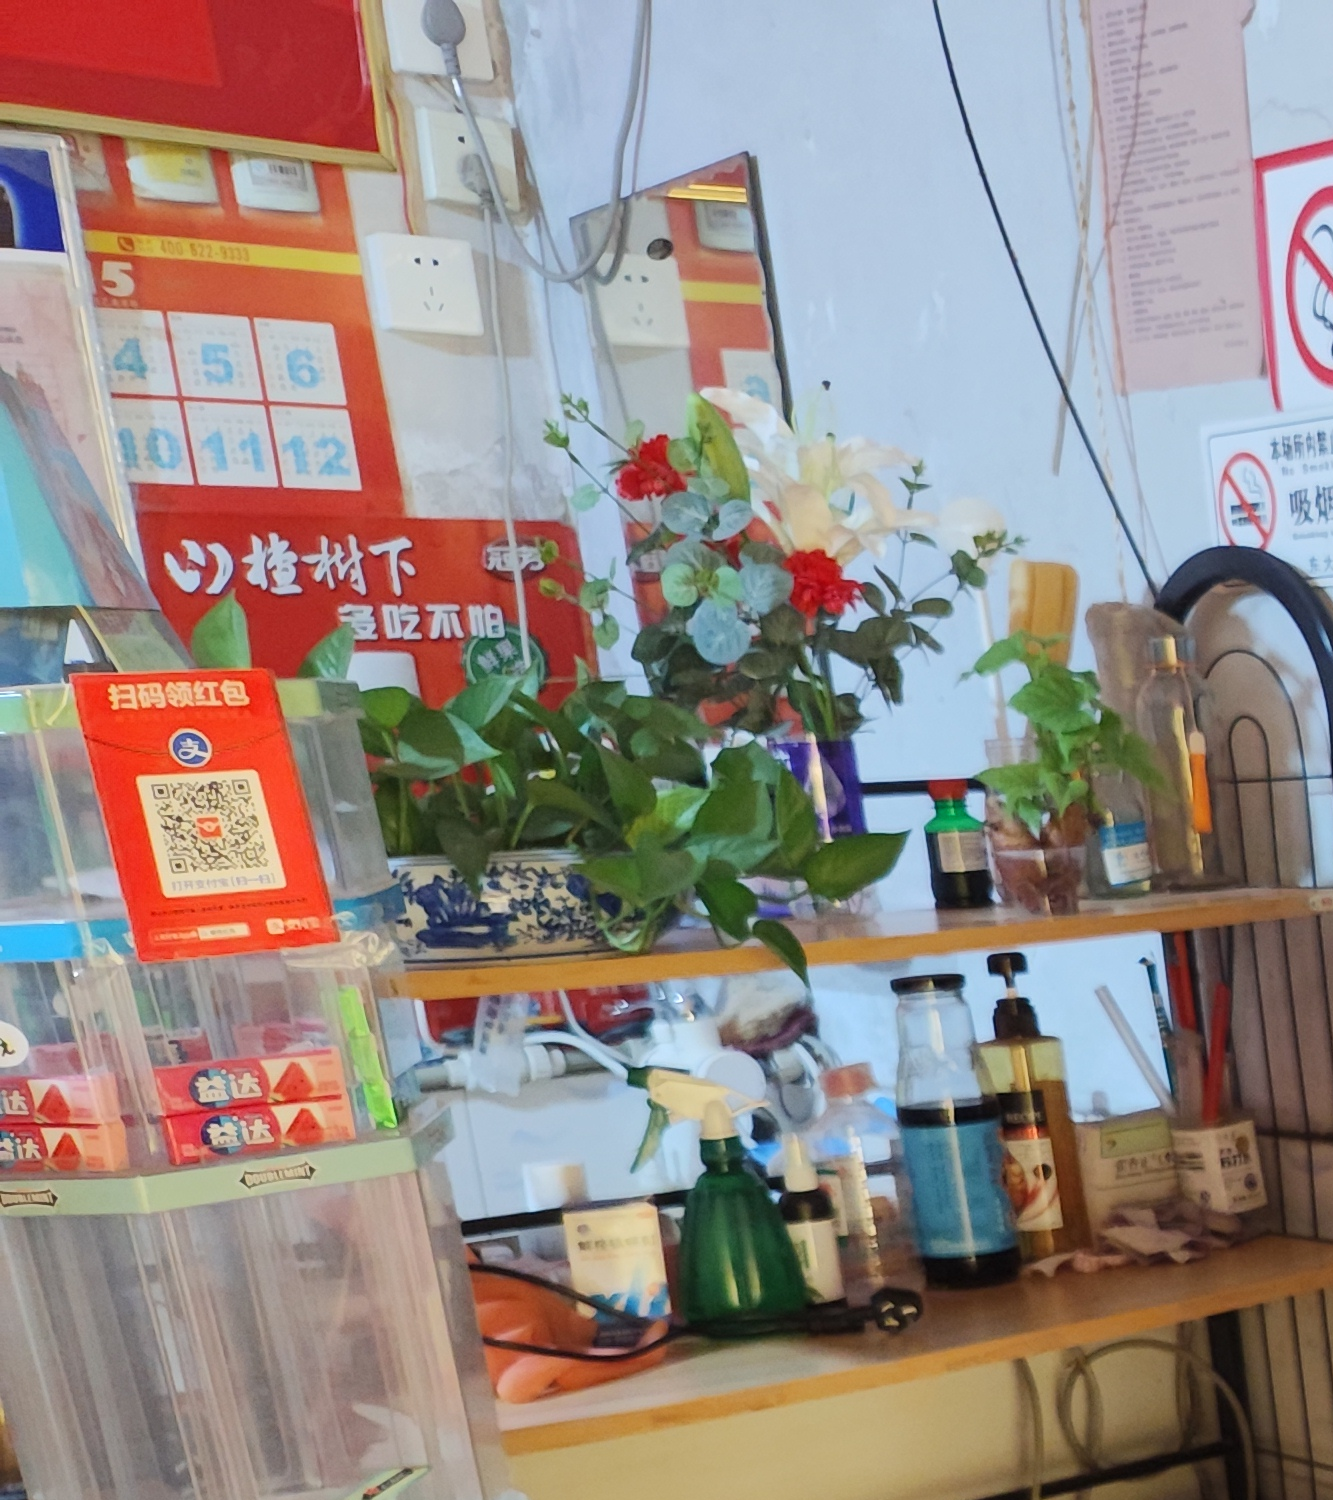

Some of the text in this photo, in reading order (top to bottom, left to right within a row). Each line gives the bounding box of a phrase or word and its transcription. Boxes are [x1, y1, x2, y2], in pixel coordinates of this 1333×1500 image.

[113, 337, 148, 379] 4
[201, 343, 234, 384] 5
[286, 349, 320, 388] 6
[117, 427, 182, 470] 10
[202, 430, 265, 472] 11
[282, 435, 350, 476] 12
[164, 533, 417, 597] 山楂树下
[108, 680, 250, 711] 扫码领红包
[0, 1088, 29, 1116] 达
[194, 1069, 265, 1103] 益达
[206, 1116, 276, 1148] 益达
[245, 1163, 311, 1188] DOUBLEMINT
